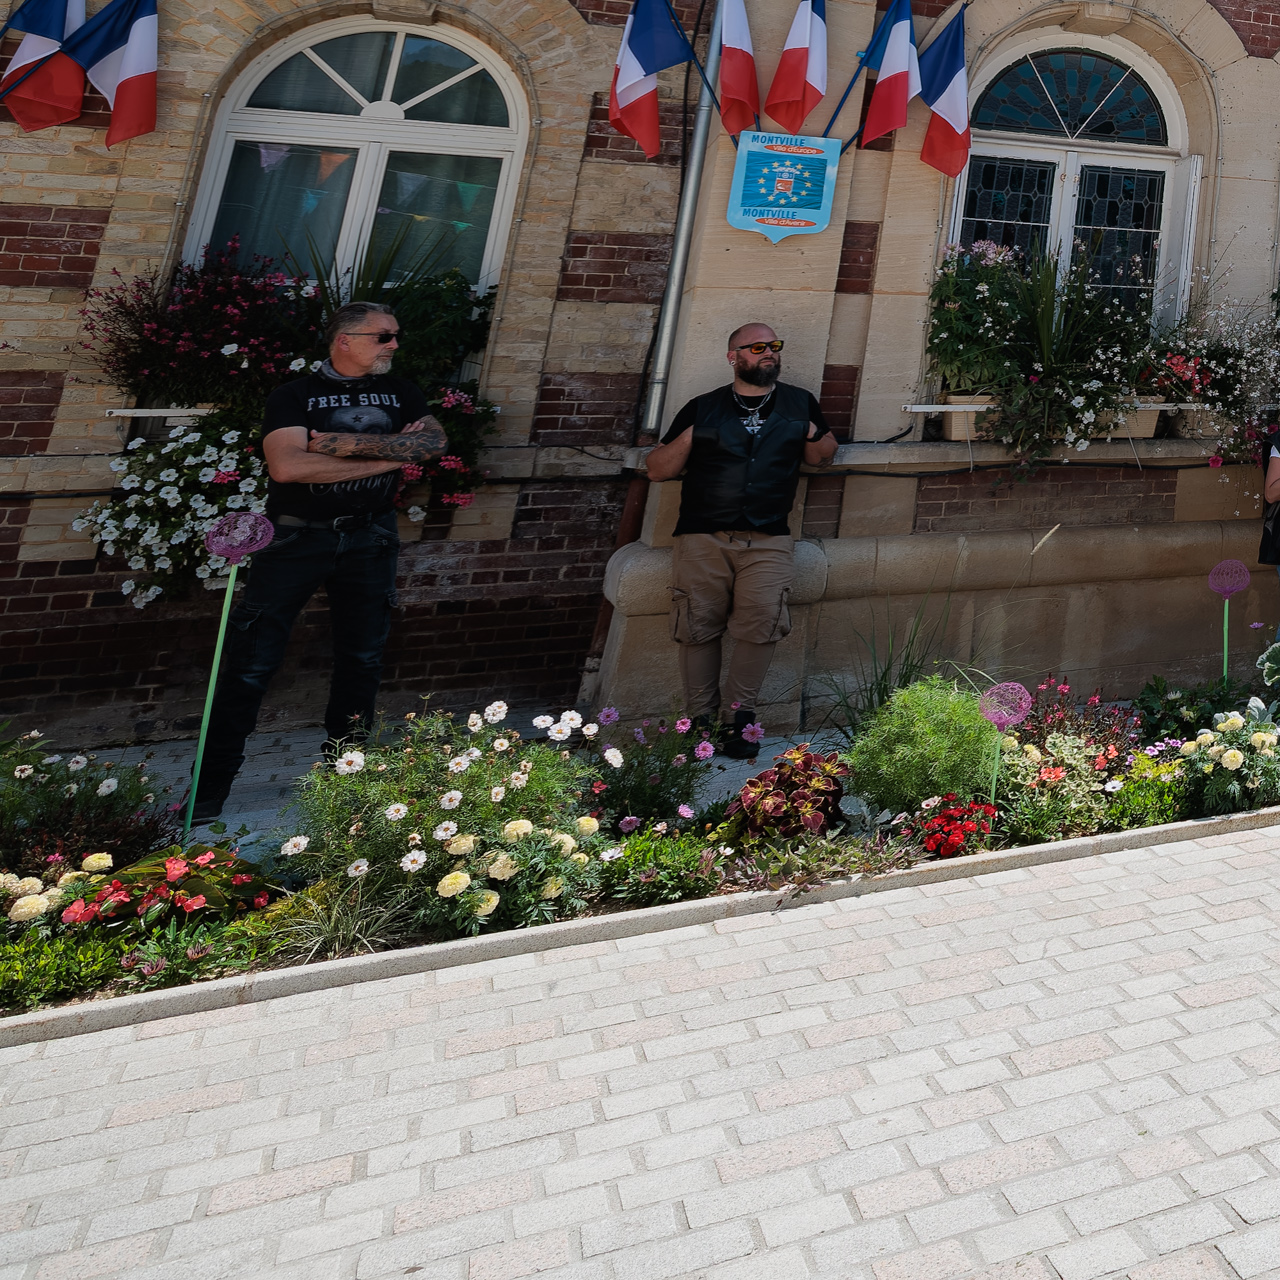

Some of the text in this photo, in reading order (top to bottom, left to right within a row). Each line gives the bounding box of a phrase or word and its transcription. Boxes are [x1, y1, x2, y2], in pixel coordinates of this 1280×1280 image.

[751, 135, 805, 147] MONTVILLE
[742, 208, 798, 220] MONTVILLE
[307, 393, 400, 412] FREE SOUL
